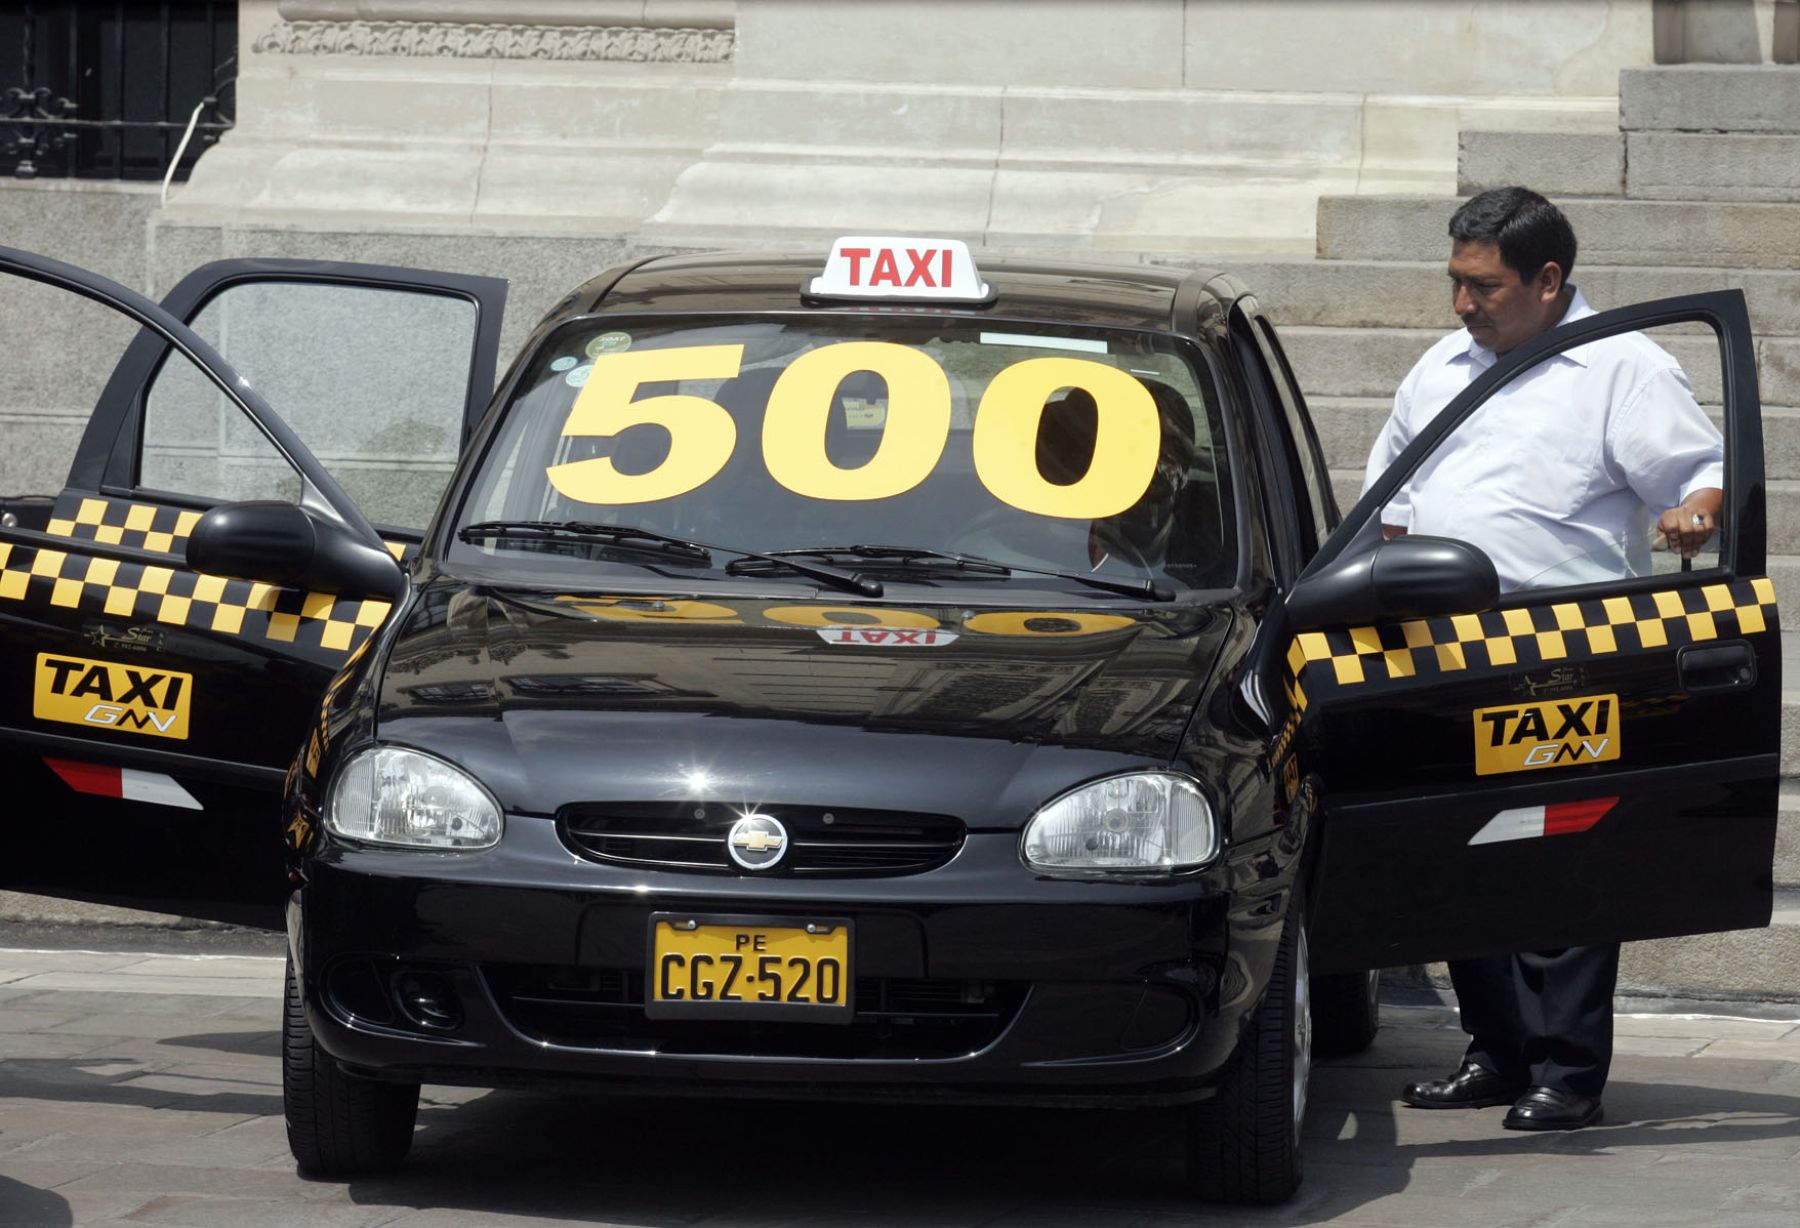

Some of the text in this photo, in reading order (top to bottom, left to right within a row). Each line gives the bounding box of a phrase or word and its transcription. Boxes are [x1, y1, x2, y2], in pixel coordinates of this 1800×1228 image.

[840, 248, 953, 288] TAXI
[546, 341, 1162, 519] 500
[45, 659, 184, 710] TAXI
[1481, 699, 1611, 747] TAXI
[735, 934, 767, 951] PE
